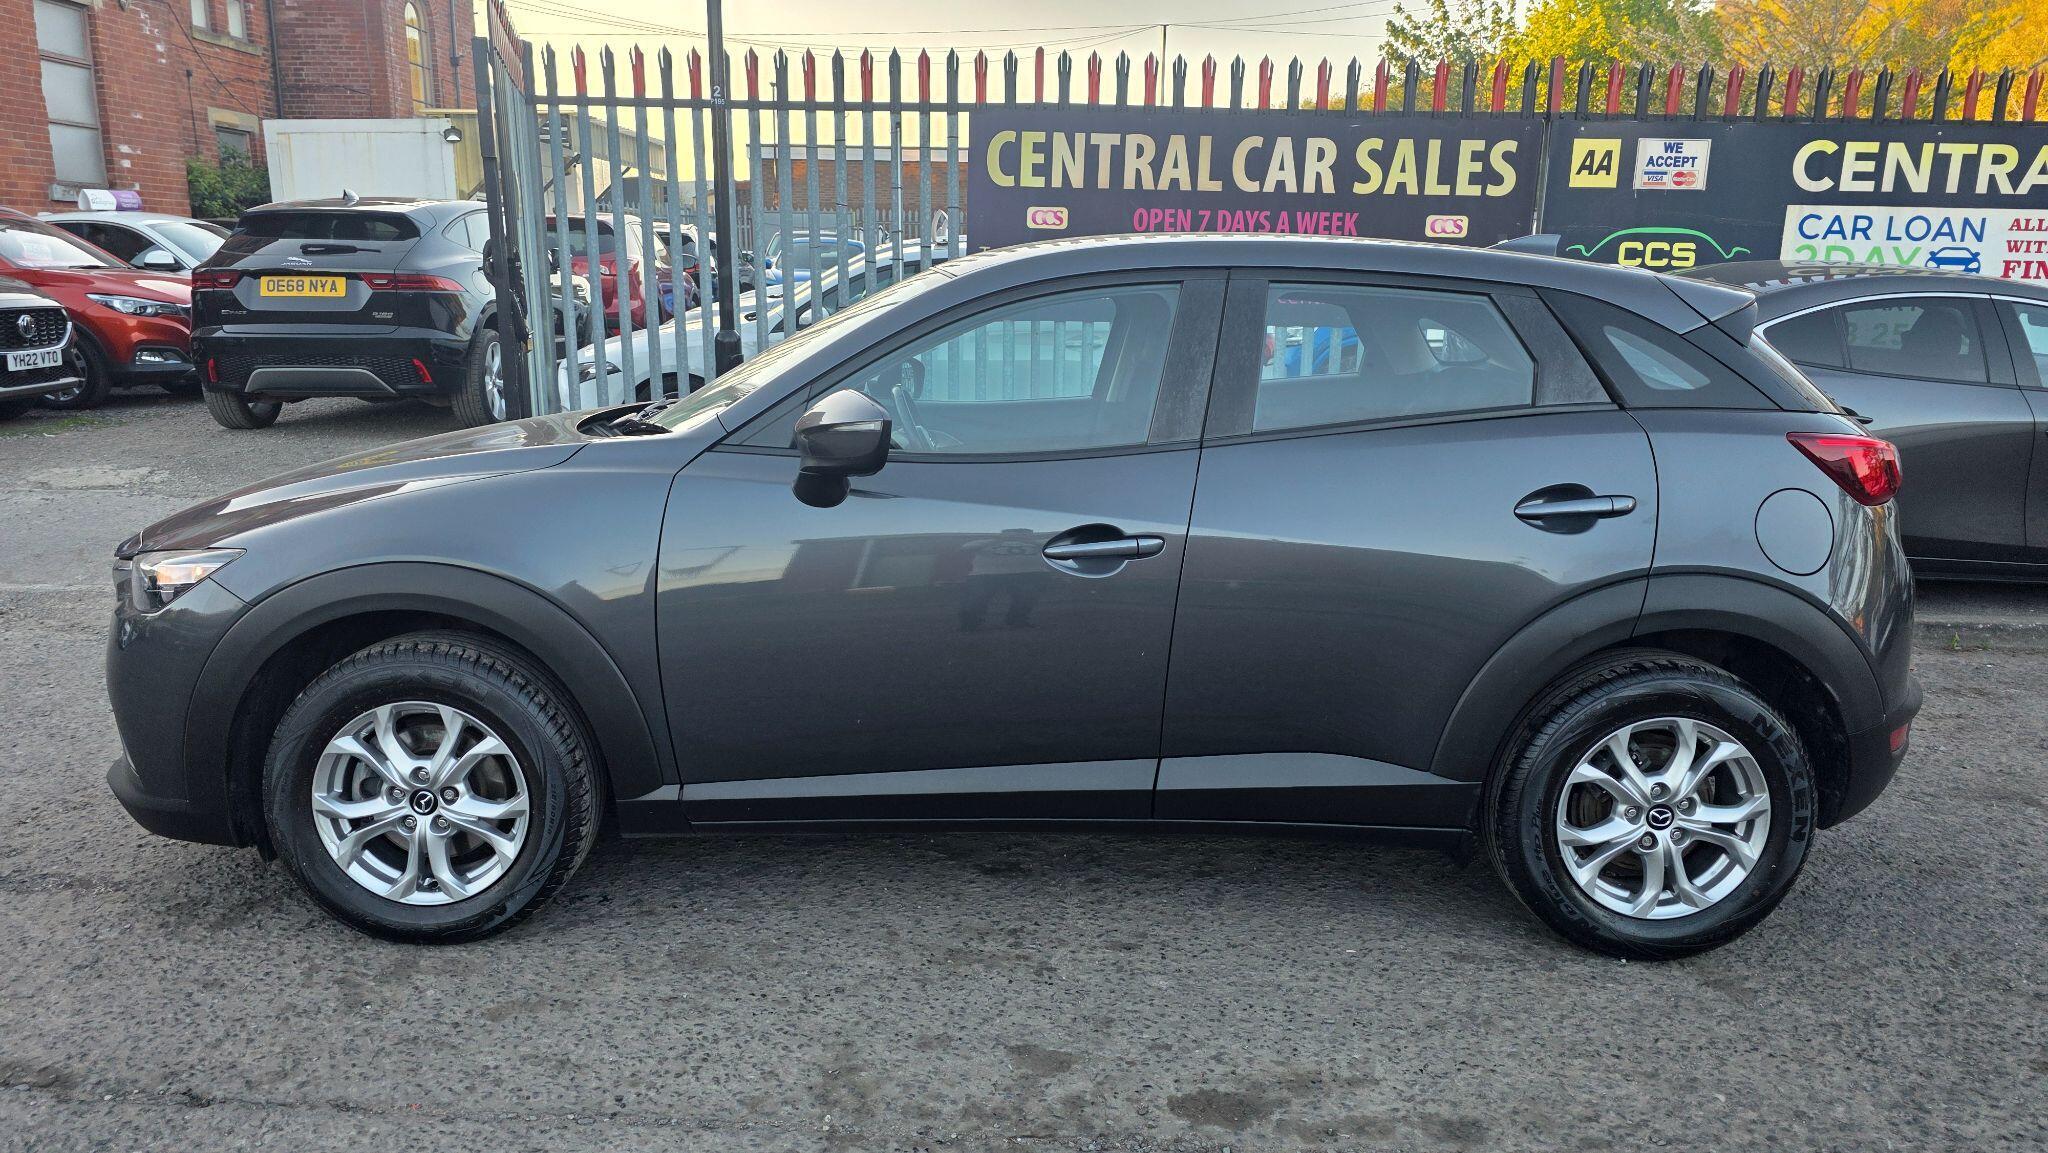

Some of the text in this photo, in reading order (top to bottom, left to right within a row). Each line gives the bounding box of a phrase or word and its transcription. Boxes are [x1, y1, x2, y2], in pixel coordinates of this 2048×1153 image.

[713, 85, 721, 97] 2
[1664, 142, 1683, 154] WE
[986, 130, 1518, 197] CENTRAL CAR SALES
[1575, 149, 1613, 176] AA
[1646, 156, 1698, 168] ACCEPT
[1032, 209, 1064, 227] CCS
[1133, 207, 1360, 236] OPEN 7 DAYS A WEEK
[1430, 218, 1464, 234] CCS
[1798, 214, 1987, 243] CAR LOAN
[1617, 241, 1697, 267] CCS
[2006, 239, 2048, 254] WIT
[266, 279, 338, 294] OE68 NYA
[12, 351, 58, 368] YH22 VTO
